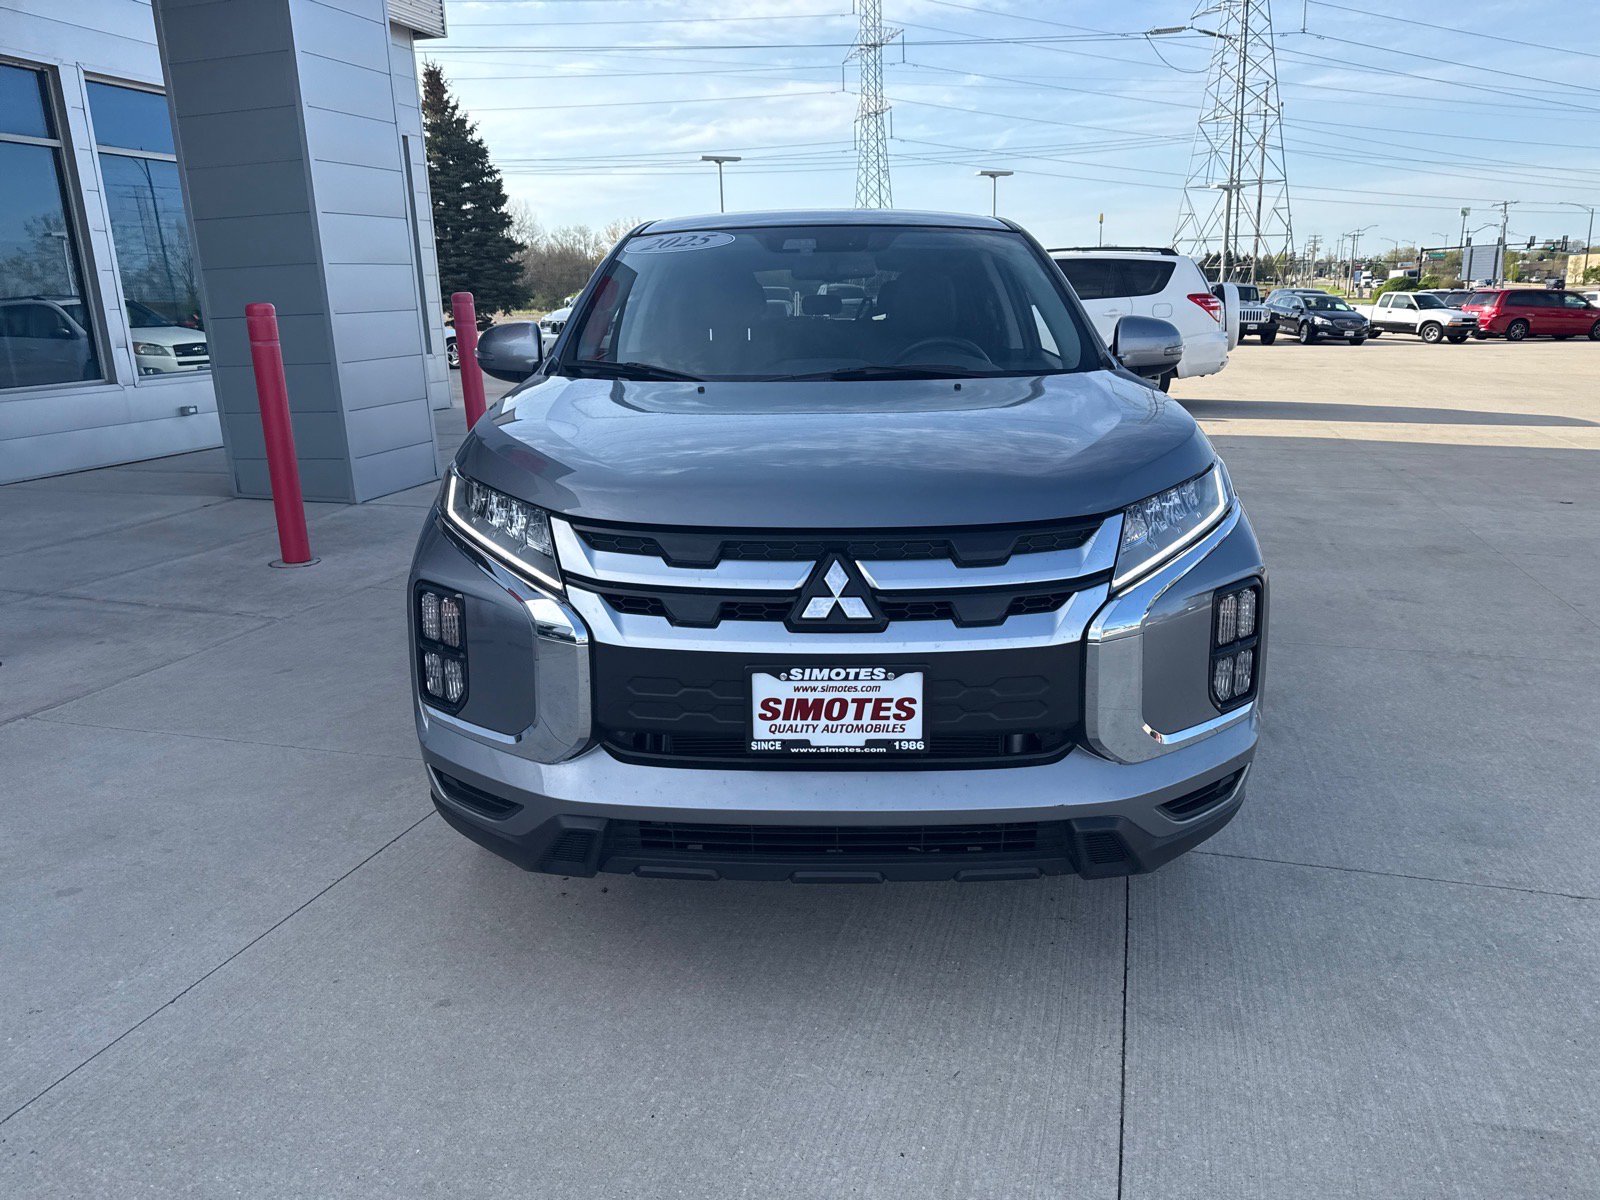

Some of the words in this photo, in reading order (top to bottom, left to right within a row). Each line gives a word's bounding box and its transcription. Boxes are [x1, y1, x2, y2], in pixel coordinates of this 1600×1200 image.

[641, 234, 717, 251] 2025
[789, 668, 887, 681] SIMOTES
[793, 684, 881, 693] www.simotes.com
[758, 697, 917, 721] SIMOTES
[768, 723, 819, 734] QUALITY
[821, 723, 906, 734] AUTOMOBILES
[751, 741, 782, 750] SINCE
[893, 741, 925, 750] 1986
